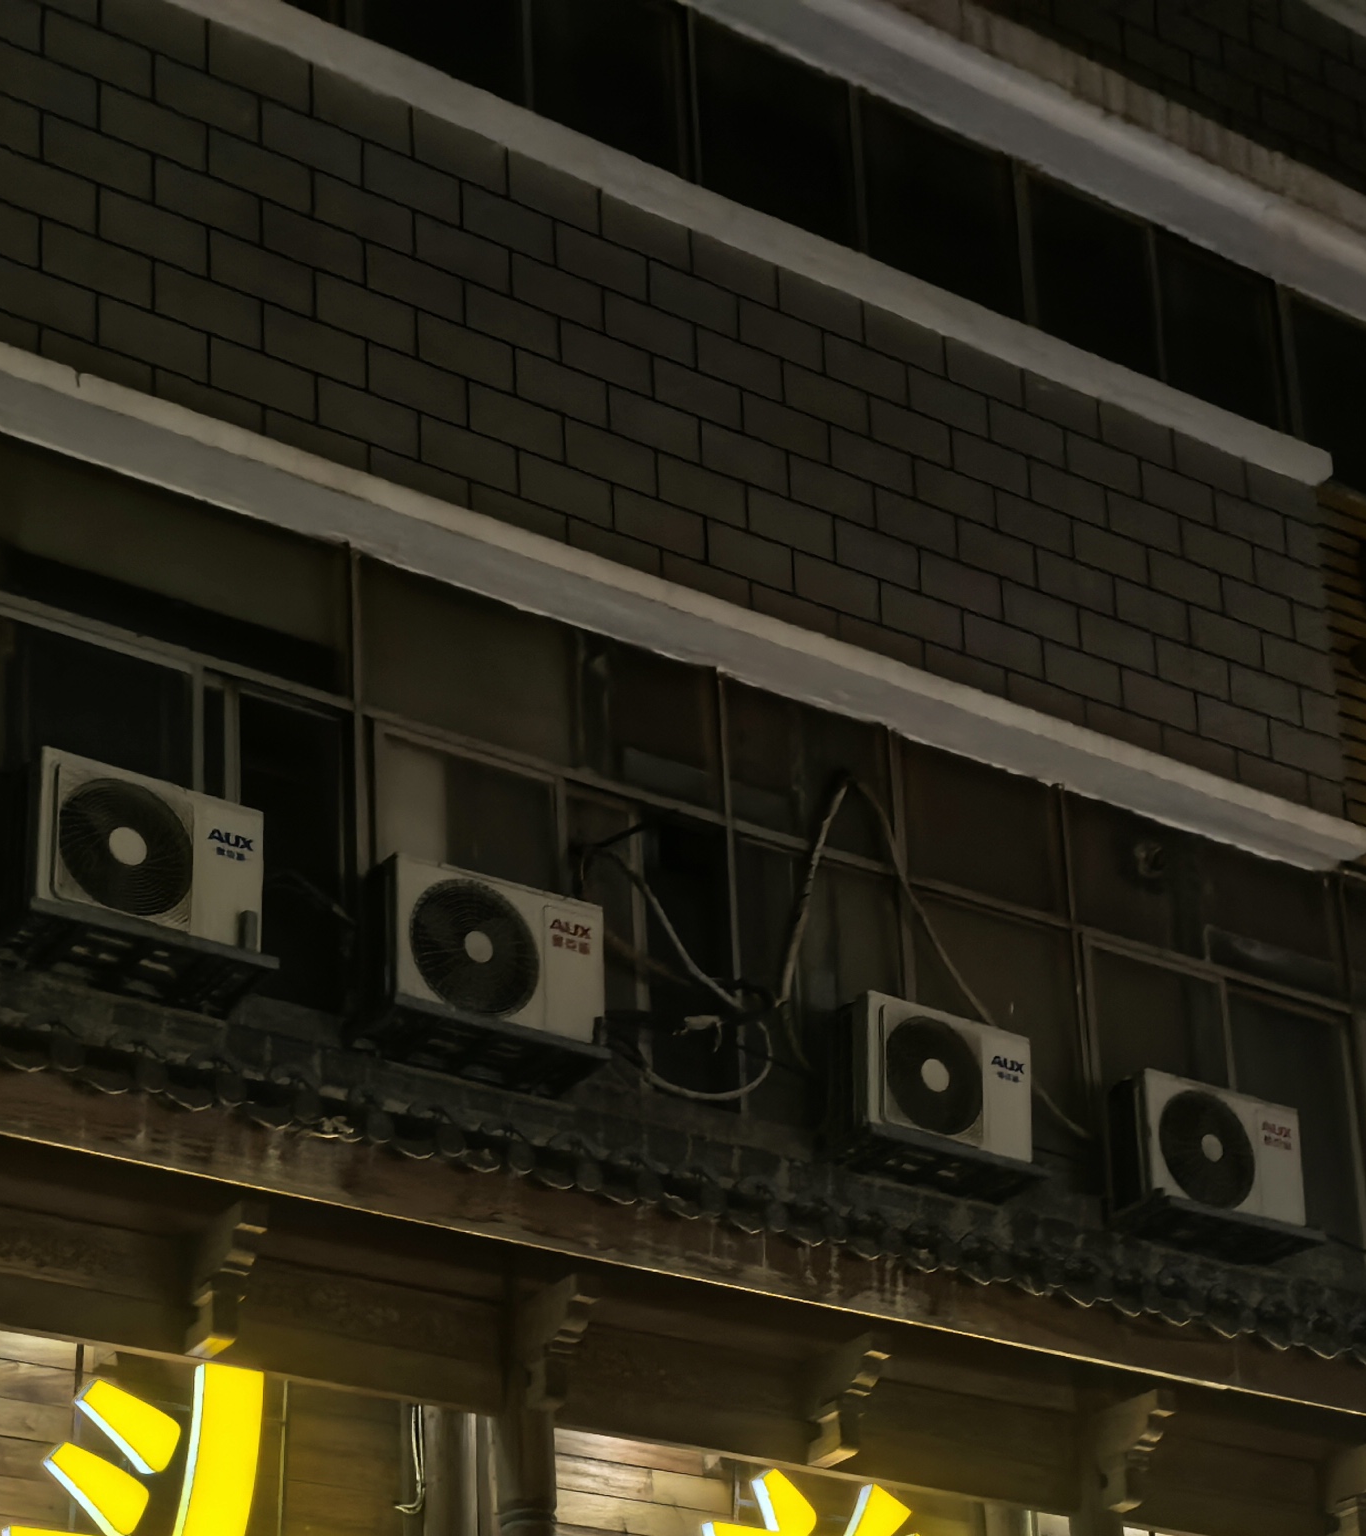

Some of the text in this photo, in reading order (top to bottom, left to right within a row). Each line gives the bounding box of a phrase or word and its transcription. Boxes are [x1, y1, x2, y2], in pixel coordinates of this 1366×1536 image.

[207, 828, 253, 852] AUX
[549, 918, 592, 940] AUX
[990, 1055, 1026, 1075] AUX
